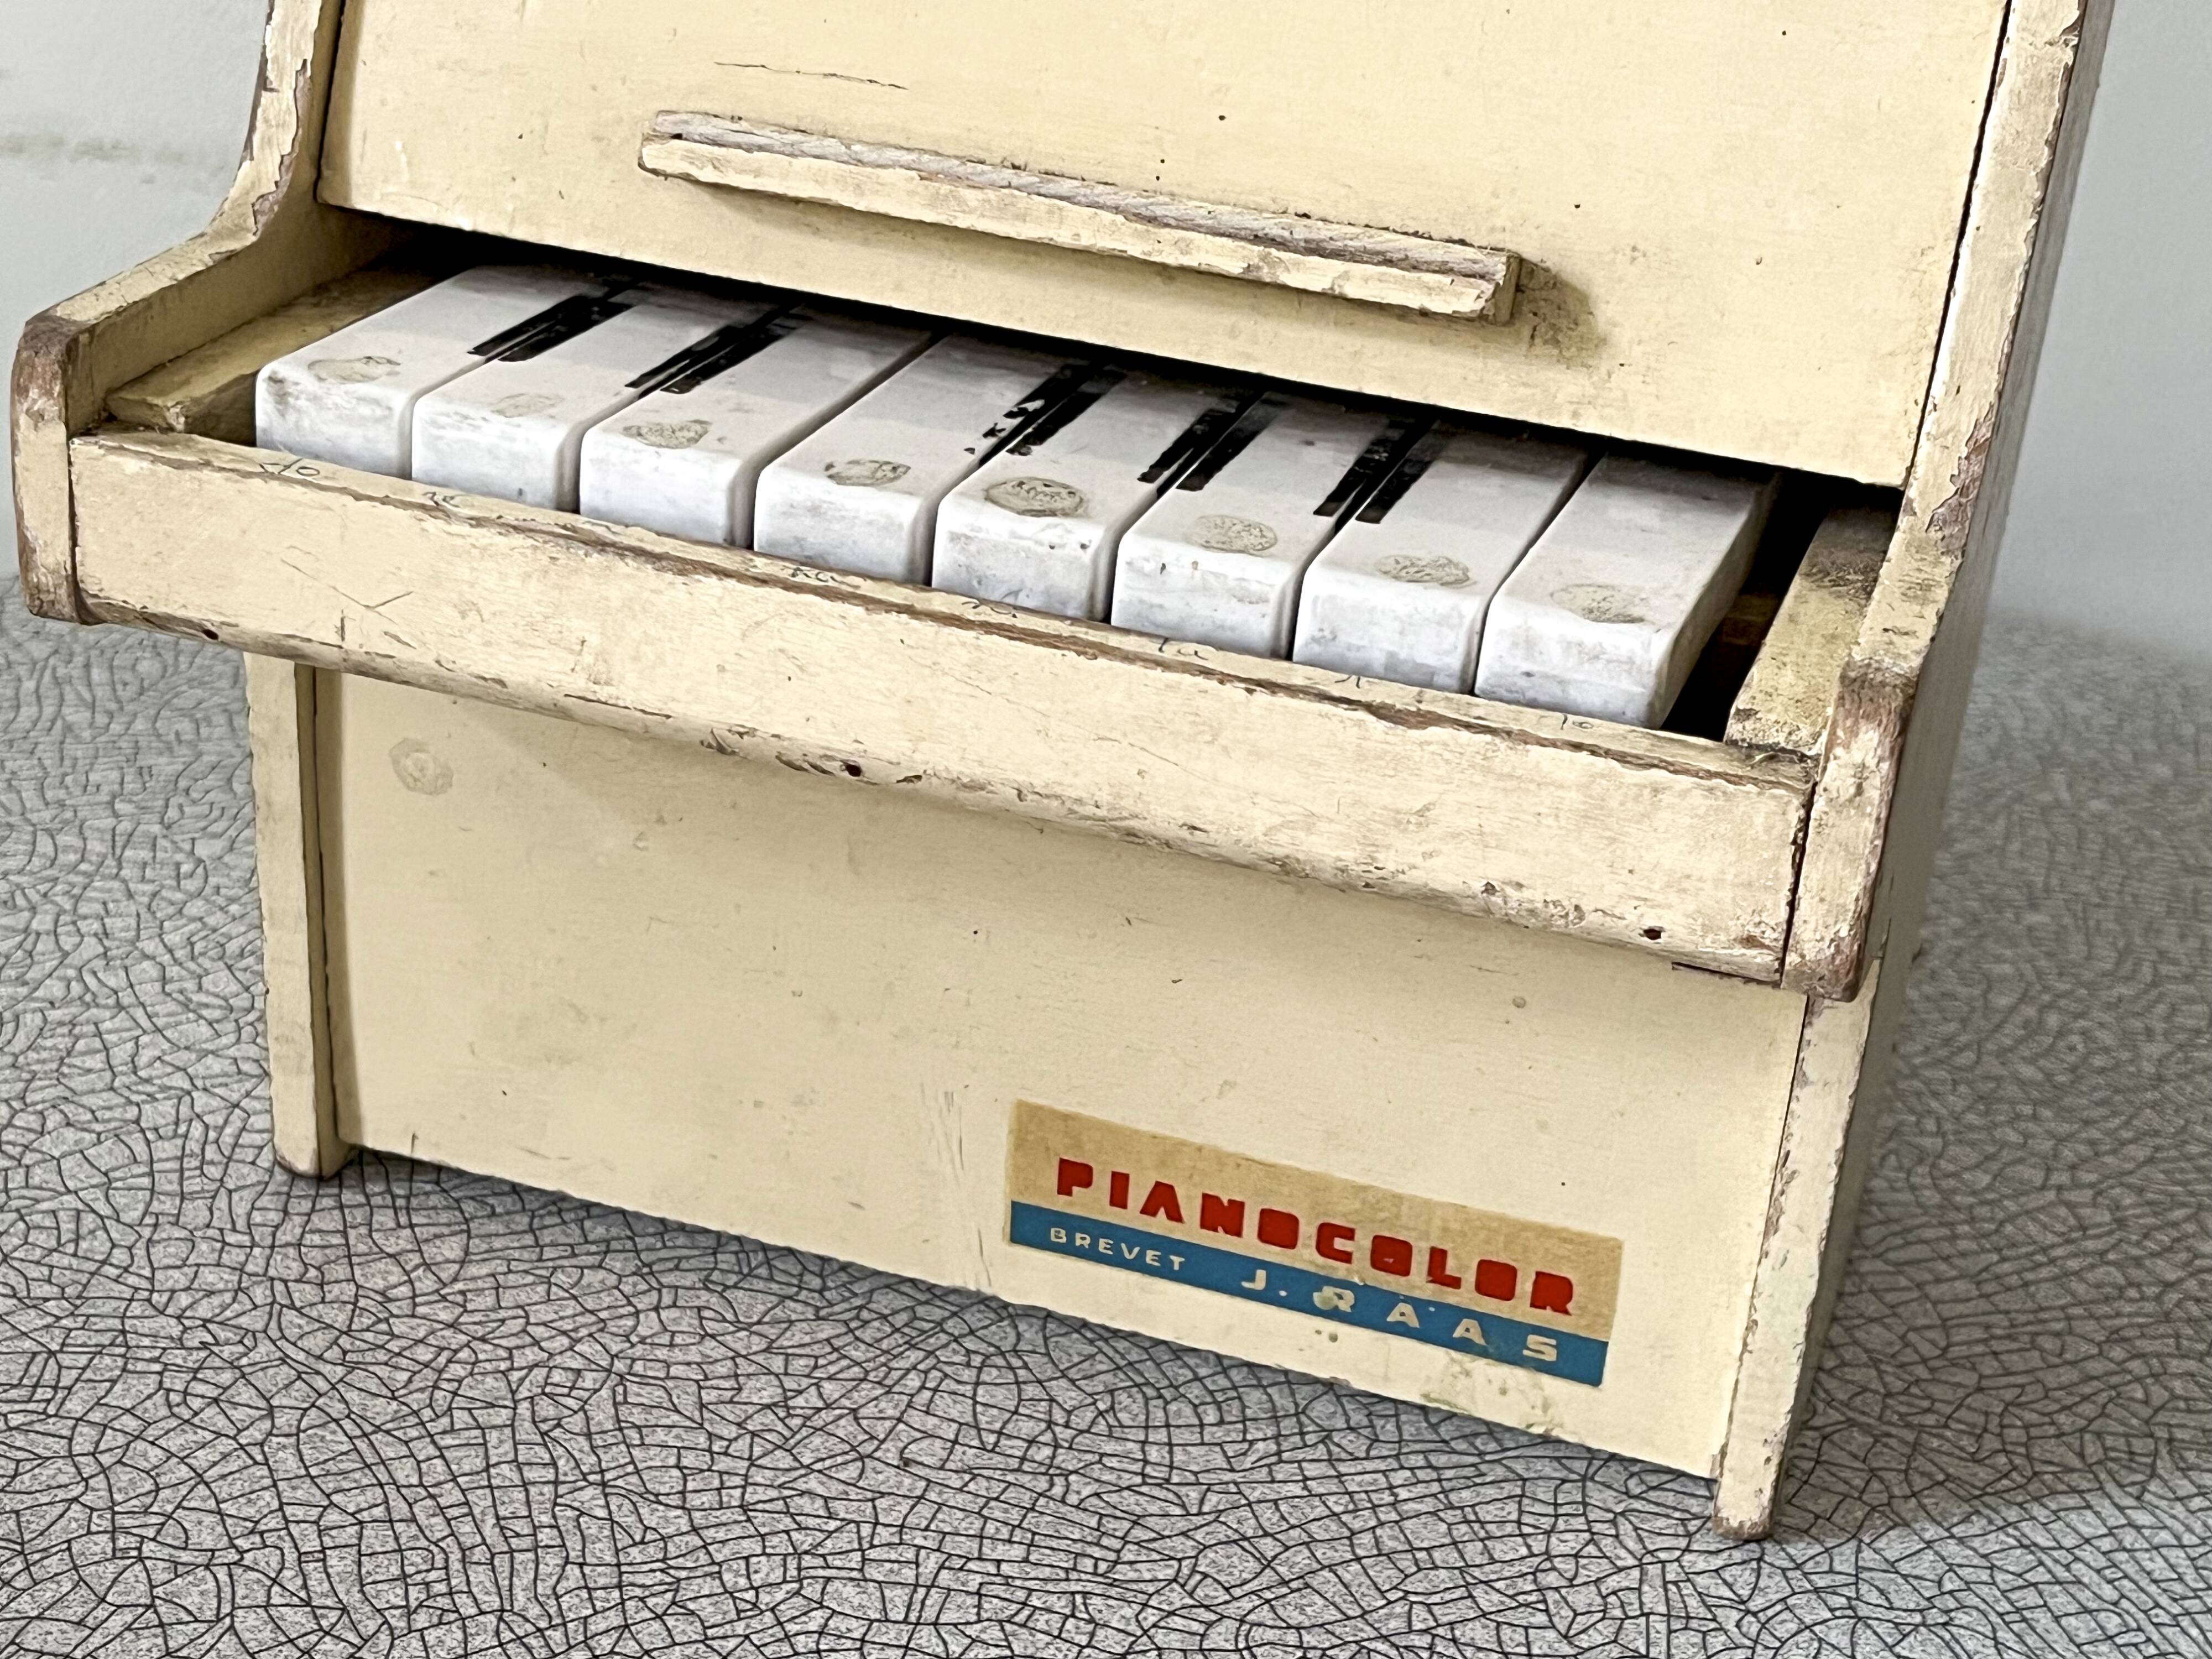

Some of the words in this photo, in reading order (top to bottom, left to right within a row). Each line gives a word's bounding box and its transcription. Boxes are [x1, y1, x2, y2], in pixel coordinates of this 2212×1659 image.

[1050, 1228, 1185, 1271] BREVET
[1241, 1269, 1287, 1297] J.
[1313, 1285, 1557, 1361] RAAS
[1057, 1157, 1573, 1316] PIANOCOLOR
